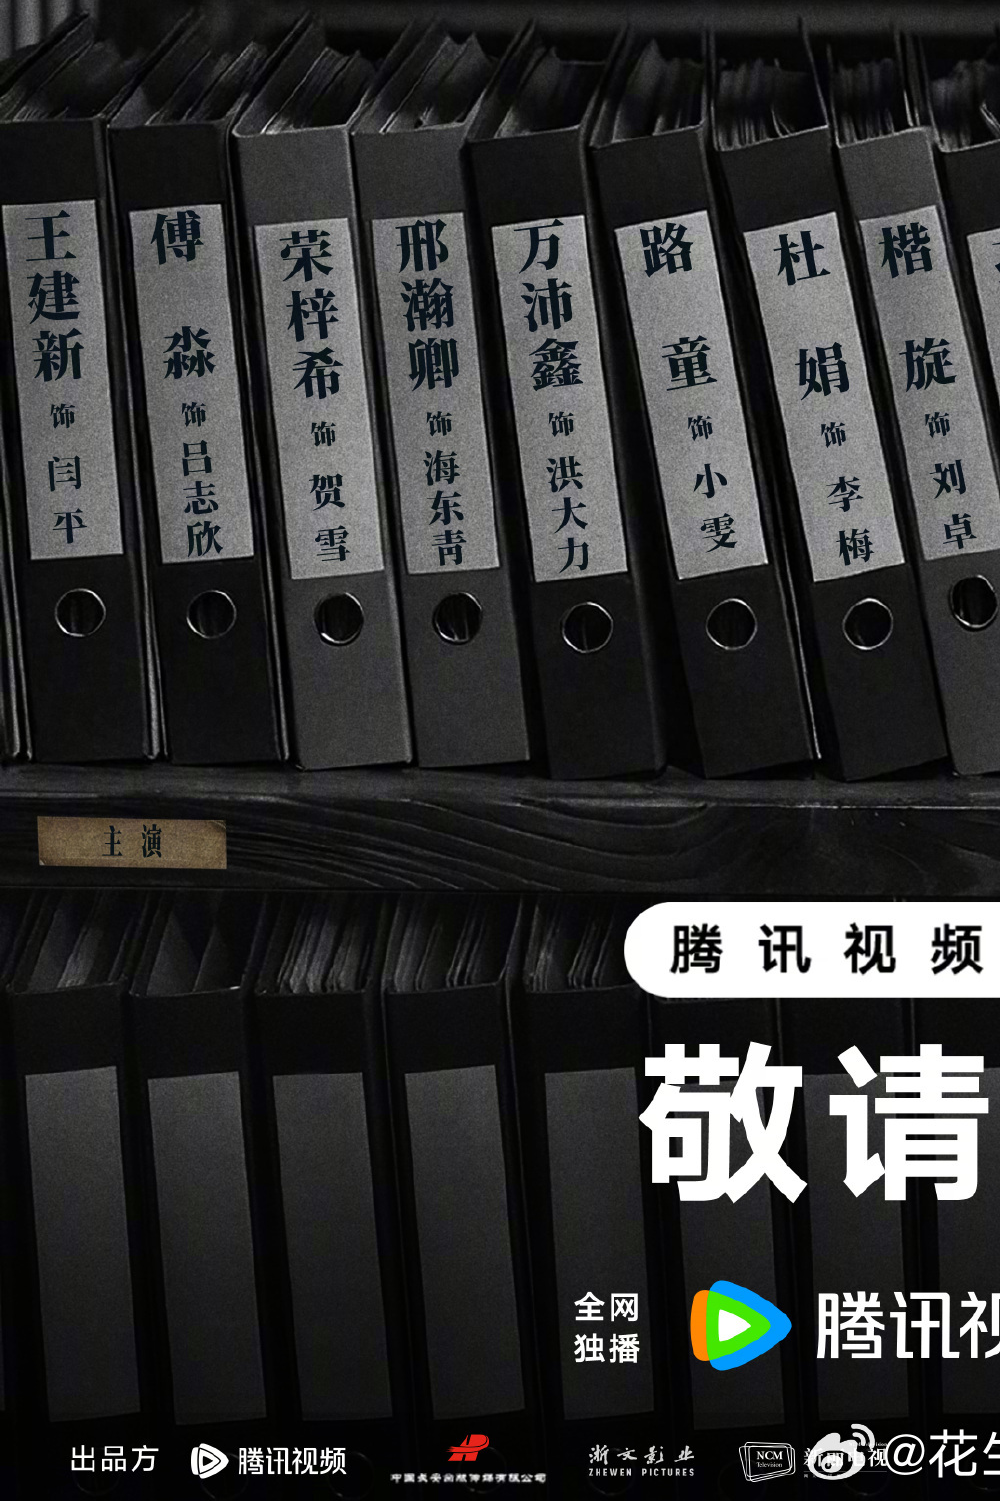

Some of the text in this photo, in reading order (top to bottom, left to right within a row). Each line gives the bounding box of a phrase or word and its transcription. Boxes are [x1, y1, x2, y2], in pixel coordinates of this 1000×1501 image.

[26, 210, 87, 544] 王建新 饰 闫平
[148, 208, 226, 559] 傅淼 饰 吕志欣
[280, 230, 349, 561] 荣梓希 饰 贺雪
[393, 217, 466, 566] 邢瀚卿 饰 海东青
[511, 217, 593, 577] 万沛鑫 饰 洪大力
[636, 220, 736, 552] 路童 饰 小雯
[771, 227, 874, 565] 杜娟 饰 李梅
[876, 220, 980, 552] 楷旋 饰 刘卓
[102, 824, 162, 858] 主演
[71, 1445, 159, 1473] 出品方
[238, 1447, 347, 1475] 腾讯视频
[573, 1291, 639, 1322] 全网
[573, 1333, 640, 1364] 独播
[756, 1450, 783, 1460] NCM
[588, 1468, 695, 1477] ZHEWEN PICTURES
